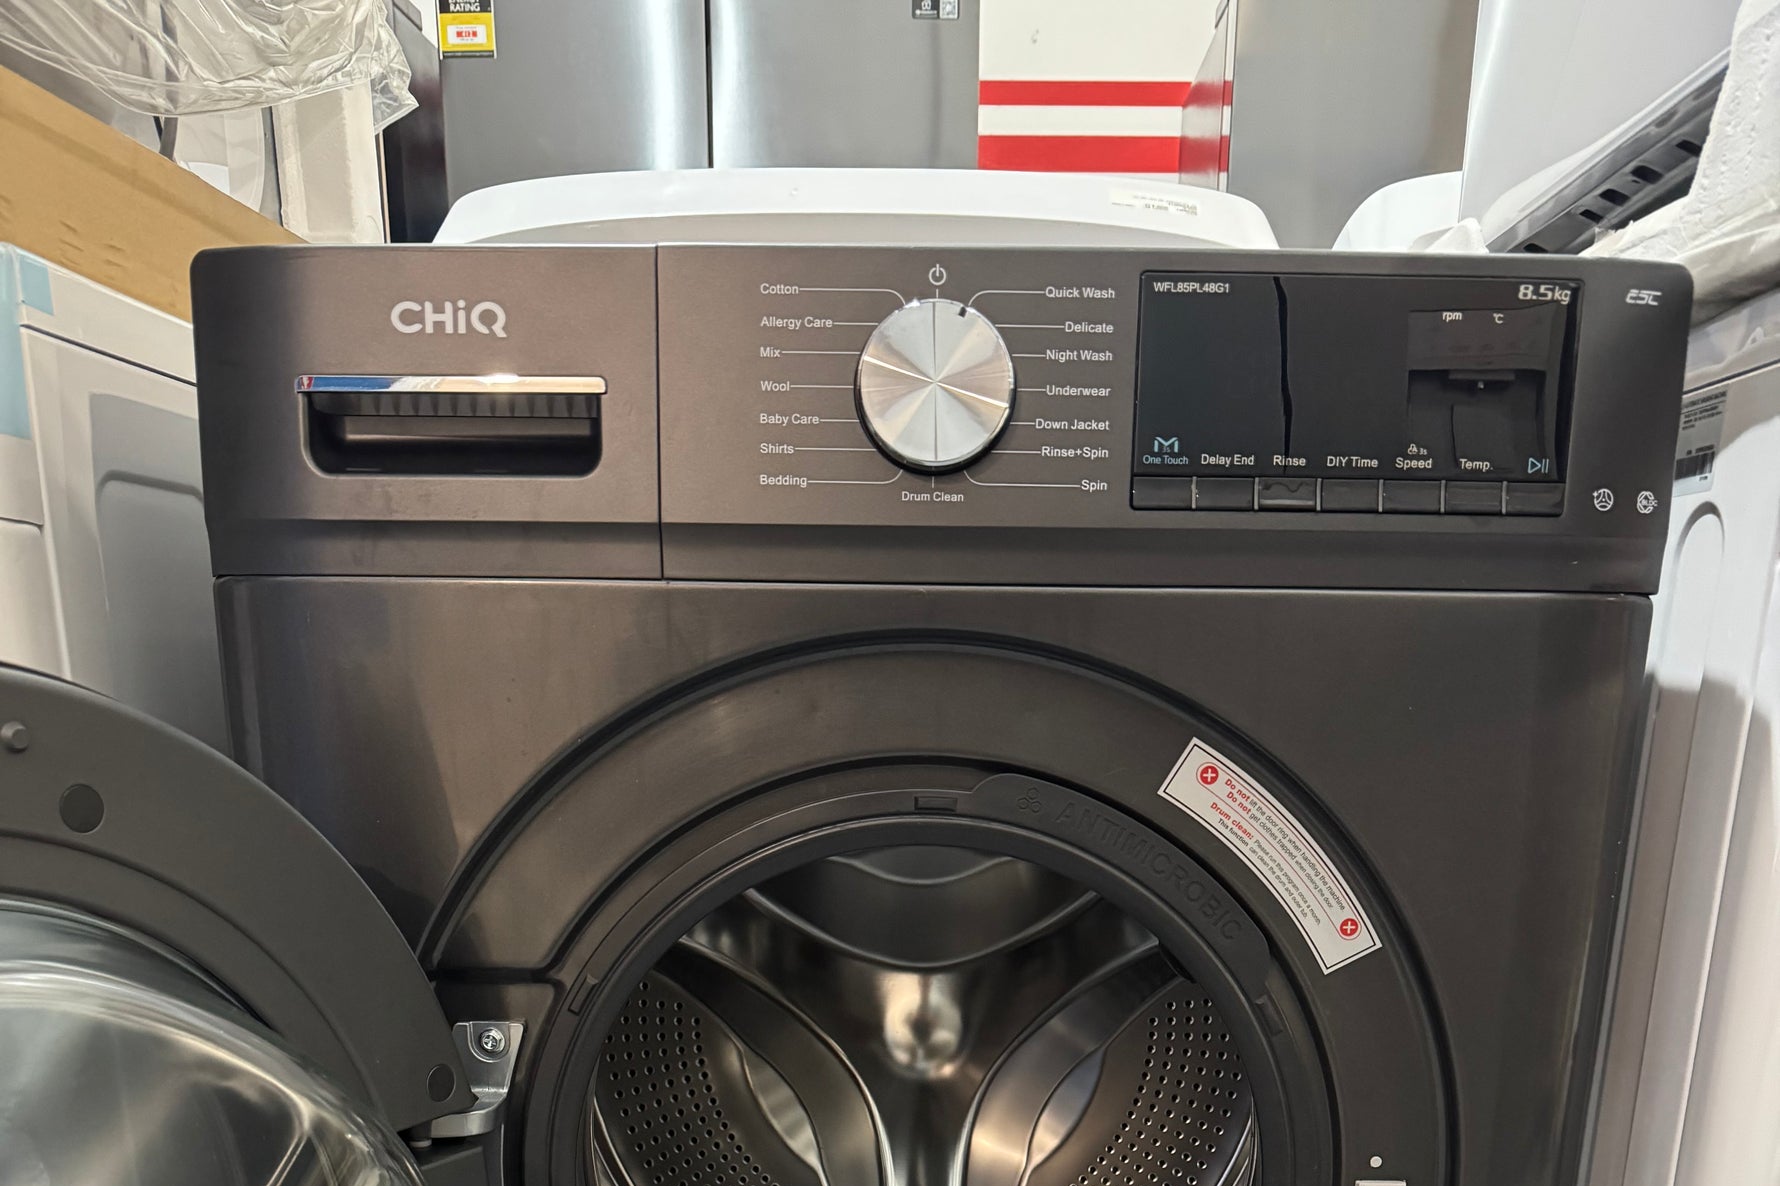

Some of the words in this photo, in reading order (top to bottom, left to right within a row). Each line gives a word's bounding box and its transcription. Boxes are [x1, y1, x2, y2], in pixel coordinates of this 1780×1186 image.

[450, 3, 481, 12] RATING
[760, 283, 799, 295] Cotton
[1045, 286, 1080, 299] Quick
[1082, 287, 1115, 299] Wash
[1153, 282, 1230, 293] WFL85PL48G1
[390, 299, 508, 338] CHiQ
[1442, 311, 1462, 322] rpm
[760, 316, 801, 330] Allergy
[804, 317, 833, 328] Care
[1064, 322, 1114, 333] Delicate
[760, 347, 781, 358] Mix
[1046, 350, 1078, 363] Night
[1080, 350, 1113, 361] Wash
[760, 381, 790, 391] Wool
[1046, 385, 1111, 396] Underwear
[760, 413, 789, 426] Baby
[791, 414, 820, 425] Care
[1035, 418, 1068, 430] Down
[1071, 419, 1109, 431] Jacket
[760, 443, 794, 454] Shirts
[1041, 446, 1109, 460] Rinse+Spin
[1142, 455, 1161, 465] One
[1164, 455, 1189, 465] Touch
[1201, 453, 1232, 467] Delay
[1233, 454, 1255, 465] End
[1273, 455, 1306, 466] Rinse
[1327, 456, 1348, 467] DIY
[1350, 457, 1378, 468] Time
[1395, 458, 1432, 470] Speed
[1459, 458, 1494, 471] Temp.
[760, 474, 807, 488] Bedding
[1081, 480, 1108, 492] Spin
[901, 491, 930, 501] Drum
[933, 491, 964, 502] Clean
[1210, 802, 1231, 821] Drum
[1231, 820, 1254, 840] clean:
[1218, 818, 1229, 830] This
[1228, 827, 1249, 847] function
[1225, 779, 1236, 790] Do
[1236, 789, 1250, 802] not
[1256, 806, 1266, 817] the
[1265, 815, 1279, 828] door
[1277, 827, 1289, 840] ring
[1288, 838, 1302, 853] when
[1300, 851, 1321, 877] handling
[1320, 875, 1328, 886] the
[1227, 791, 1237, 803] Do
[1238, 802, 1252, 814] not
[1249, 813, 1261, 823] get
[1259, 821, 1278, 841] clothes
[1277, 839, 1297, 860] trapped
[1295, 860, 1307, 874] when
